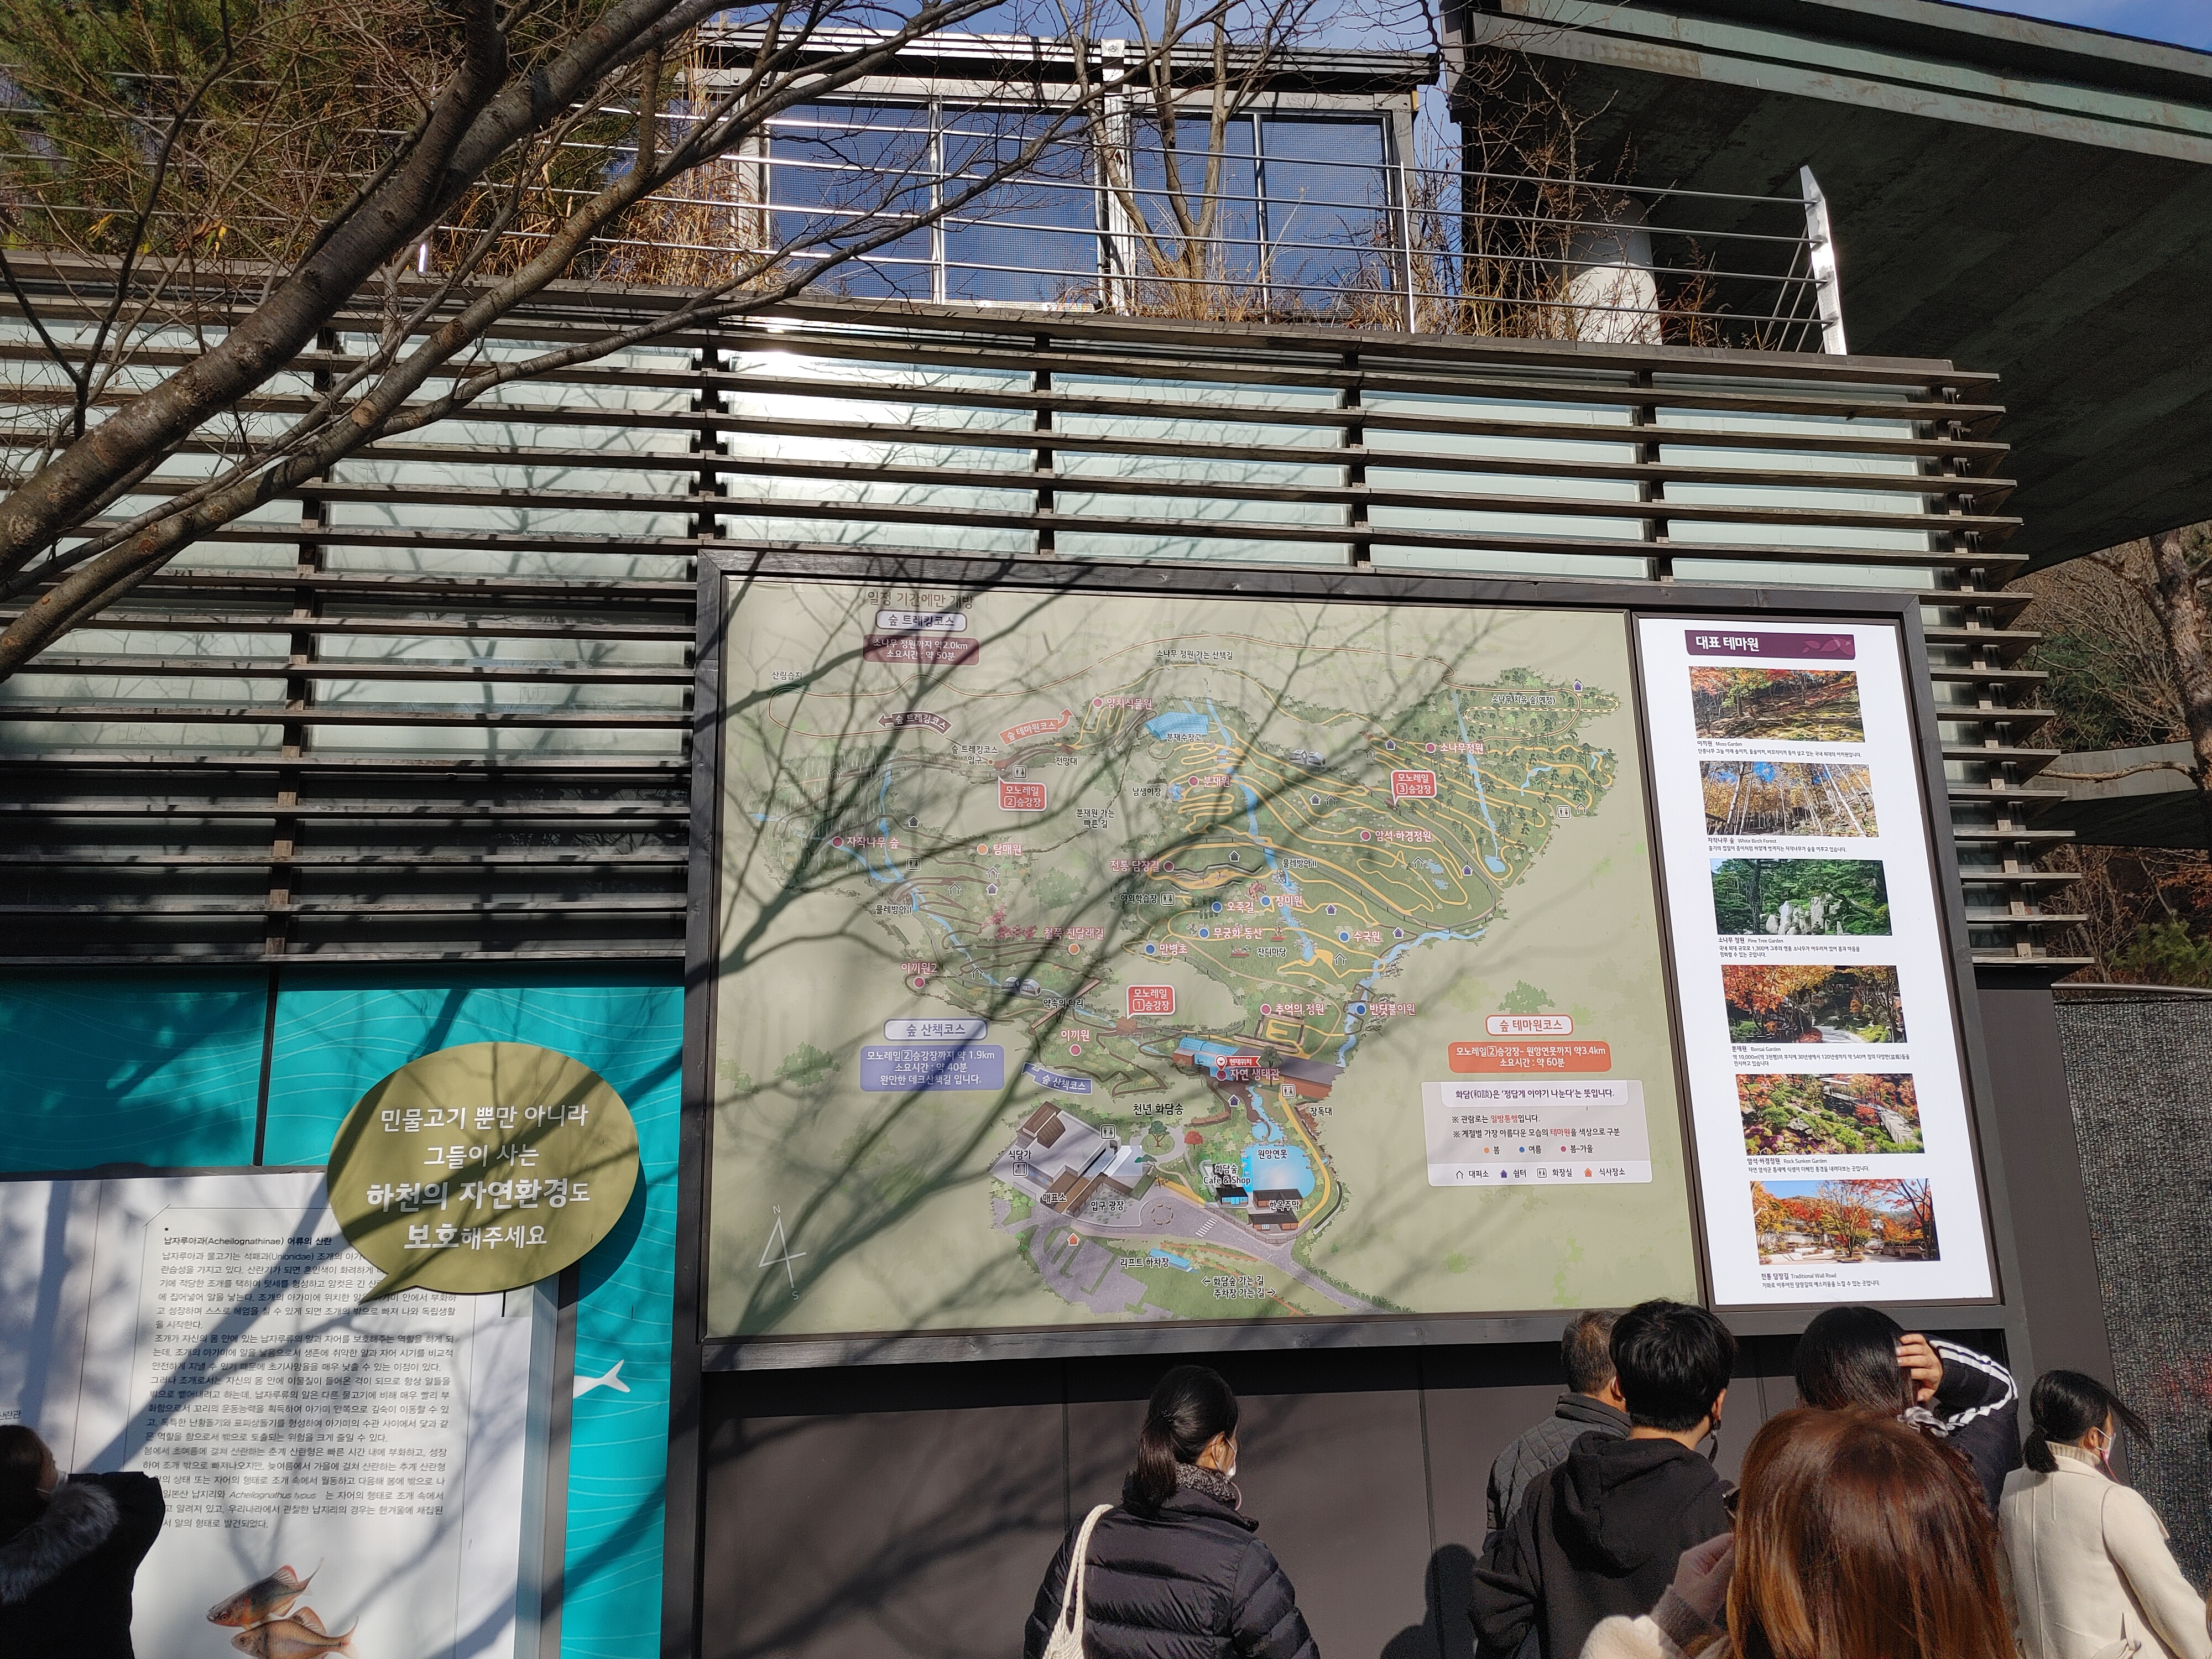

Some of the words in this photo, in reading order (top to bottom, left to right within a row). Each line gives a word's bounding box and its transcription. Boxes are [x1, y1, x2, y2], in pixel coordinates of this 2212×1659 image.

[868, 592, 892, 606] 일정
[898, 593, 946, 608] 기간에만
[950, 596, 974, 609] 개방
[888, 615, 898, 625] 숲
[902, 614, 955, 628] 트레킹코스
[874, 639, 898, 649] 소나무
[900, 639, 932, 650] 정원까지
[935, 641, 968, 650] 약2.0km
[1696, 636, 1721, 649] 대표
[1723, 637, 1759, 652] 테마원
[886, 650, 918, 660] 소요시간
[926, 650, 933, 660] 약
[936, 651, 955, 661] 50분
[1157, 650, 1177, 658] 소나무
[1180, 650, 1194, 659] 정원
[1196, 650, 1210, 659] 가는
[1212, 650, 1233, 660] 산책길
[771, 671, 802, 681] 산림습지
[1107, 698, 1152, 709] 양치식물원
[1492, 696, 1511, 704] 소나무
[1514, 695, 1527, 704] 치유
[1530, 696, 1556, 706] 숲(예정)
[896, 716, 903, 724] 숲
[906, 714, 947, 730] 트레킹코스
[1007, 731, 1015, 740] 숲
[1016, 721, 1056, 737] 테마원코스
[1166, 733, 1202, 742] 분재수장고
[951, 745, 958, 754] 숲
[961, 745, 998, 754] 트레킹코스
[1441, 743, 1484, 754] 소나무정원
[967, 755, 982, 765] 입구
[1056, 757, 1077, 766] 전망대
[1203, 776, 1230, 787] 분재원
[1398, 774, 1428, 783] 모노레일
[1005, 786, 1039, 795] 모노레일
[1133, 787, 1161, 796] 남생이장
[1083, 820, 1098, 828] 빠른
[1101, 820, 1108, 829] 길
[847, 837, 886, 849] 자작나무
[889, 838, 899, 849] 숲
[993, 844, 1022, 855] 탐매원
[1110, 860, 1129, 872] 전통
[1131, 860, 1159, 873] 담장길
[1282, 859, 1311, 868] 물레방아
[1120, 895, 1157, 904] 야외학습장
[1275, 895, 1302, 907] 장미원
[876, 905, 906, 915] 물레방아
[1227, 902, 1254, 913] 오죽길
[1213, 928, 1240, 940] 무궁화
[1244, 928, 1262, 939] 동산
[1353, 931, 1380, 942] 수국원
[1160, 944, 1187, 956] 만병초
[1258, 948, 1286, 957] 잔디마당
[901, 963, 937, 974] 이끼원2
[1134, 989, 1167, 999] 모노레일
[1044, 999, 1066, 1009] 약속의
[1068, 999, 1083, 1009] 다리
[1275, 1004, 1303, 1015] 추억의
[1306, 1004, 1324, 1015] 정원
[906, 1024, 917, 1035] 숲
[921, 1024, 966, 1036] 산책코스
[1500, 1021, 1509, 1032] 숲
[1512, 1020, 1562, 1031] 테마원코스
[1061, 1029, 1089, 1042] 이끼원
[1526, 1046, 1572, 1056] 원앙연못까지
[1574, 1046, 1605, 1055] 약3.4km
[957, 1051, 966, 1062] 약
[969, 1051, 994, 1060] 1.9km
[1500, 1058, 1530, 1067] 소요시간
[1537, 1058, 1545, 1067] 약
[1547, 1058, 1565, 1067] 60분
[894, 1063, 928, 1072] 소요시간
[936, 1063, 945, 1072] 약
[947, 1063, 967, 1073] 40분
[880, 1075, 906, 1085] 완만한
[909, 1074, 951, 1085] 데크산책길
[954, 1074, 981, 1084] 입니다.
[1230, 1069, 1249, 1081] 자연
[1252, 1069, 1280, 1081] 생태관
[1042, 1075, 1050, 1084] 숲
[1053, 1078, 1086, 1091] 산책코스
[1528, 1089, 1549, 1098] 이야기
[1584, 1089, 1614, 1098] 뜻입니다.
[1133, 1104, 1151, 1116] 천년
[1155, 1103, 1183, 1115] 화담송
[1310, 1107, 1332, 1117] 장독대
[380, 1107, 465, 1131] 민물고기
[474, 1106, 517, 1129] 뿐만
[524, 1104, 588, 1127] 아니라
[1460, 1115, 1488, 1124] 관람로는
[1490, 1114, 1540, 1123] 일방통행입니다.
[1462, 1130, 1482, 1138] 계절별
[1484, 1129, 1498, 1138] 가장
[1500, 1129, 1527, 1138] 아름다운
[1528, 1129, 1548, 1138] 모습의
[1550, 1129, 1577, 1137] 테마원을
[1258, 1150, 1287, 1159] 원앙연못
[1494, 1146, 1500, 1155] 봄
[1528, 1145, 1541, 1154] 여름
[424, 1145, 488, 1169] 그들이
[497, 1144, 539, 1166] 사는
[1008, 1150, 1031, 1160] 식당가
[1215, 1164, 1238, 1174] 화담숲
[1469, 1170, 1489, 1178] 대피소
[1514, 1170, 1526, 1178] 쉼터
[1552, 1169, 1572, 1177] 화장실
[1599, 1168, 1625, 1176] 식사장소
[1230, 1176, 1250, 1186] Shop
[367, 1181, 448, 1212] 하천의
[459, 1178, 591, 1209] 자연환경도
[1042, 1193, 1066, 1202] 매표소
[773, 1204, 780, 1214] N
[1091, 1202, 1106, 1212] 입구
[1108, 1201, 1124, 1211] 광장
[1270, 1201, 1299, 1211] 한옥주막
[288, 1237, 311, 1245] 어류의
[315, 1237, 332, 1245] 산란
[404, 1224, 547, 1250] 보호해주세요
[1120, 1258, 1142, 1267] 리프트
[1145, 1258, 1169, 1268] 하차장
[1213, 1276, 1236, 1287] 화담숲
[1239, 1276, 1253, 1286] 가는
[1256, 1276, 1264, 1286] 길
[1214, 1288, 1237, 1298] 주차장
[1239, 1288, 1254, 1298] 가는
[1257, 1288, 1265, 1298] 길
